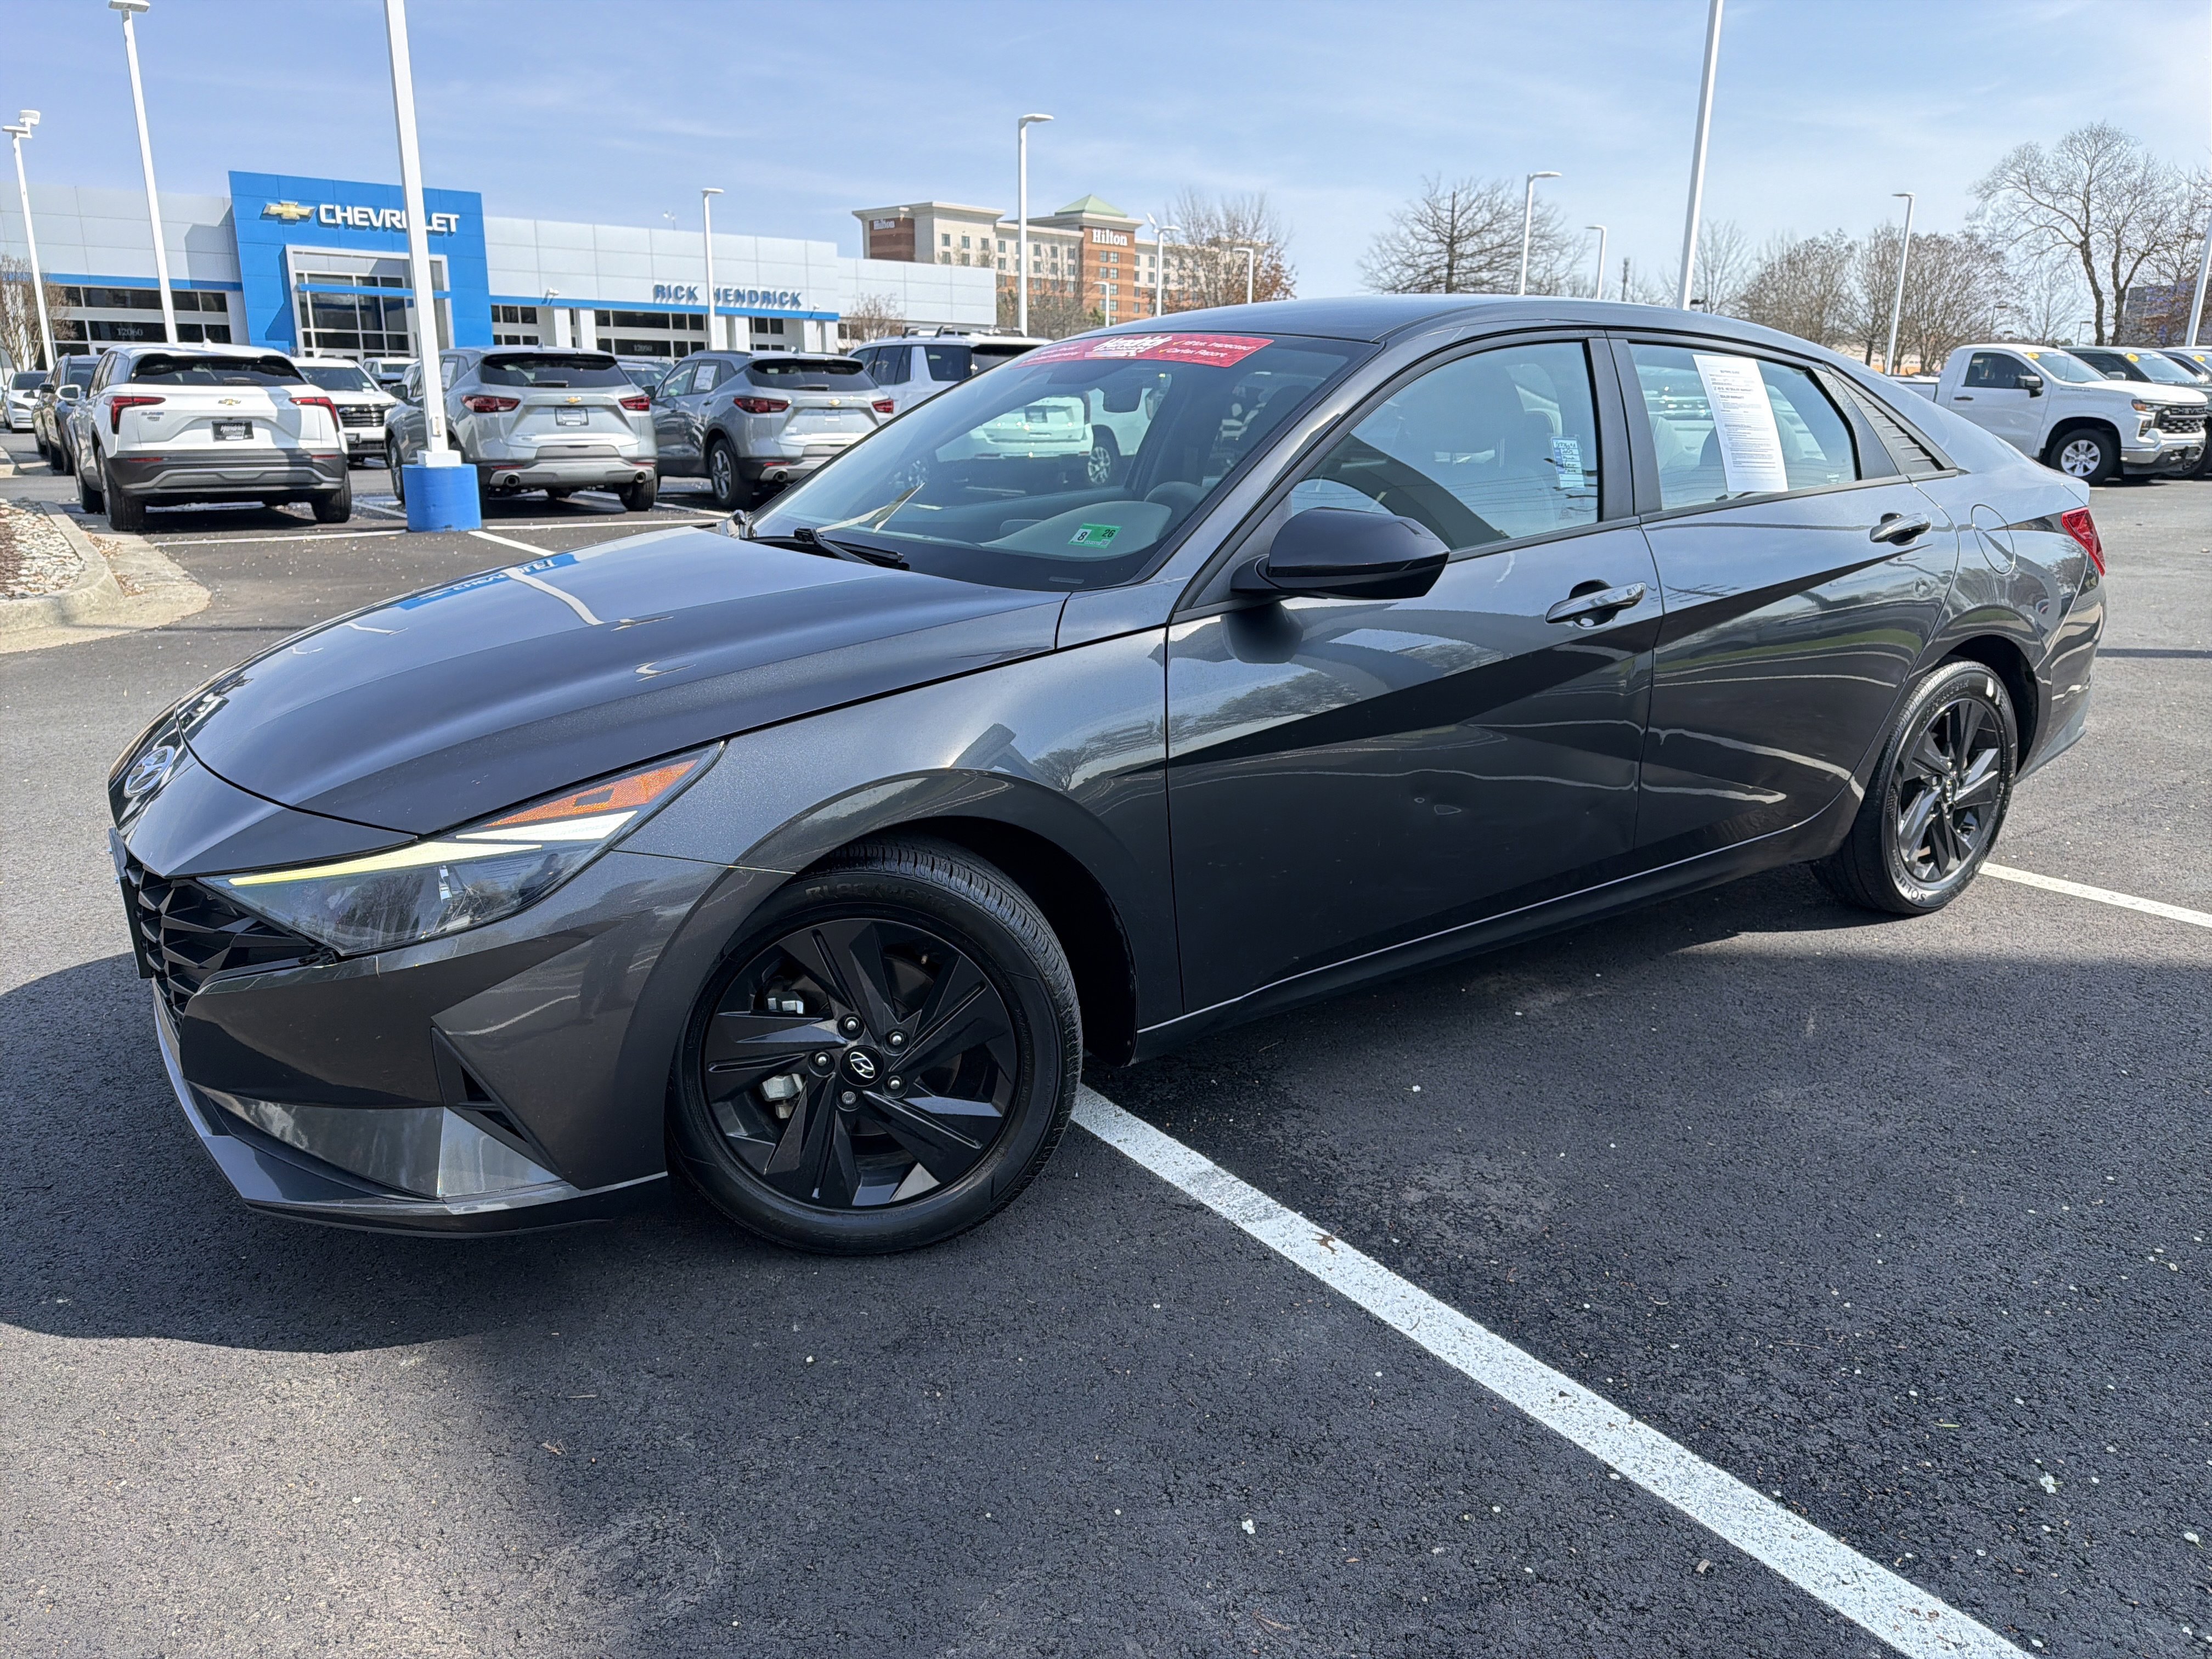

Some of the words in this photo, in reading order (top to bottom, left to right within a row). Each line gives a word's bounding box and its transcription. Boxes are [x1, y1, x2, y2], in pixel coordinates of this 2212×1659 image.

[319, 204, 460, 233] CHEVRET
[1092, 229, 1128, 246] Hilton
[653, 285, 698, 302] RICK
[713, 287, 802, 308] HENDRICK
[1077, 531, 1088, 541] 8
[1102, 529, 1116, 538] 26
[1894, 868, 1926, 902] SOLUS
